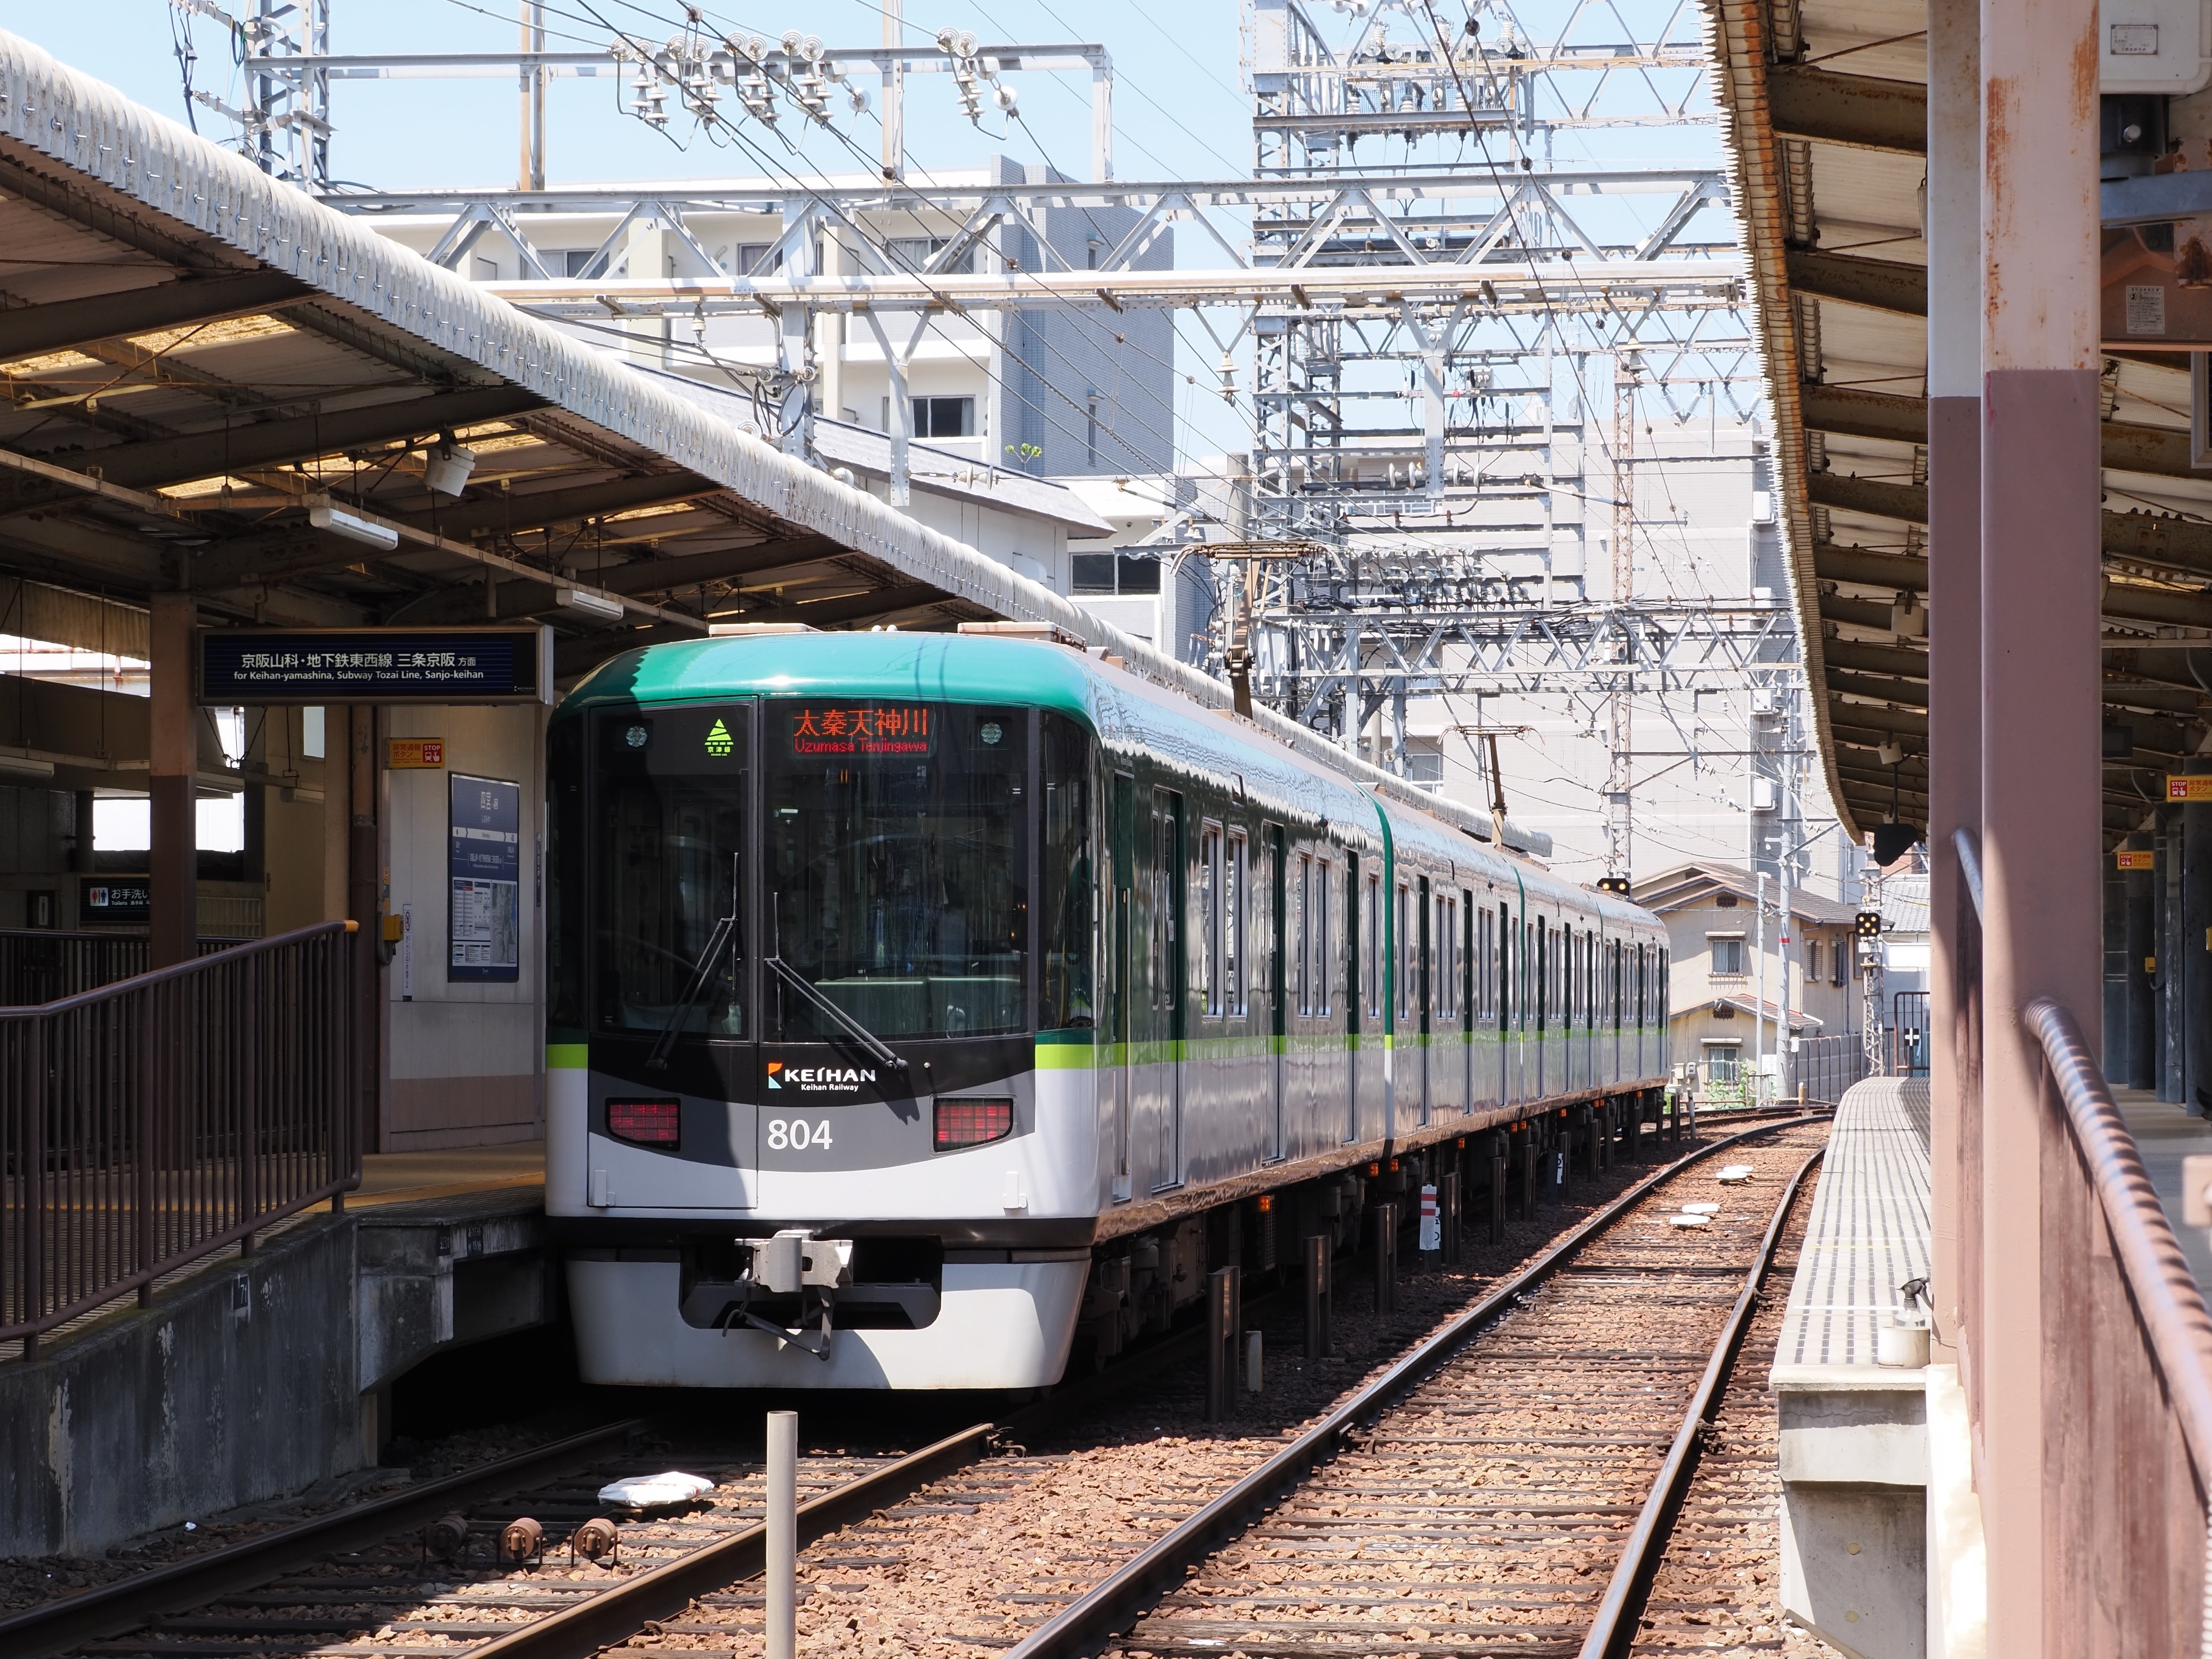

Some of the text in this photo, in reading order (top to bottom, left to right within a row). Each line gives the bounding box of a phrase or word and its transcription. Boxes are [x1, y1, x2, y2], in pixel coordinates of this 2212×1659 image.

[241, 653, 476, 668] 京阪山科・地下鉄東西線 三条京阪 方面
[234, 670, 483, 681] for Keihan-yamashina, Subway Tozai Line, Sanjo-keihan
[794, 709, 927, 736] 太秦天神川
[794, 737, 927, 753] Uzumasa Tenjingawa
[785, 1067, 876, 1082] KEIHAN
[829, 1084, 859, 1092] Railway
[768, 1119, 832, 1150] 804
